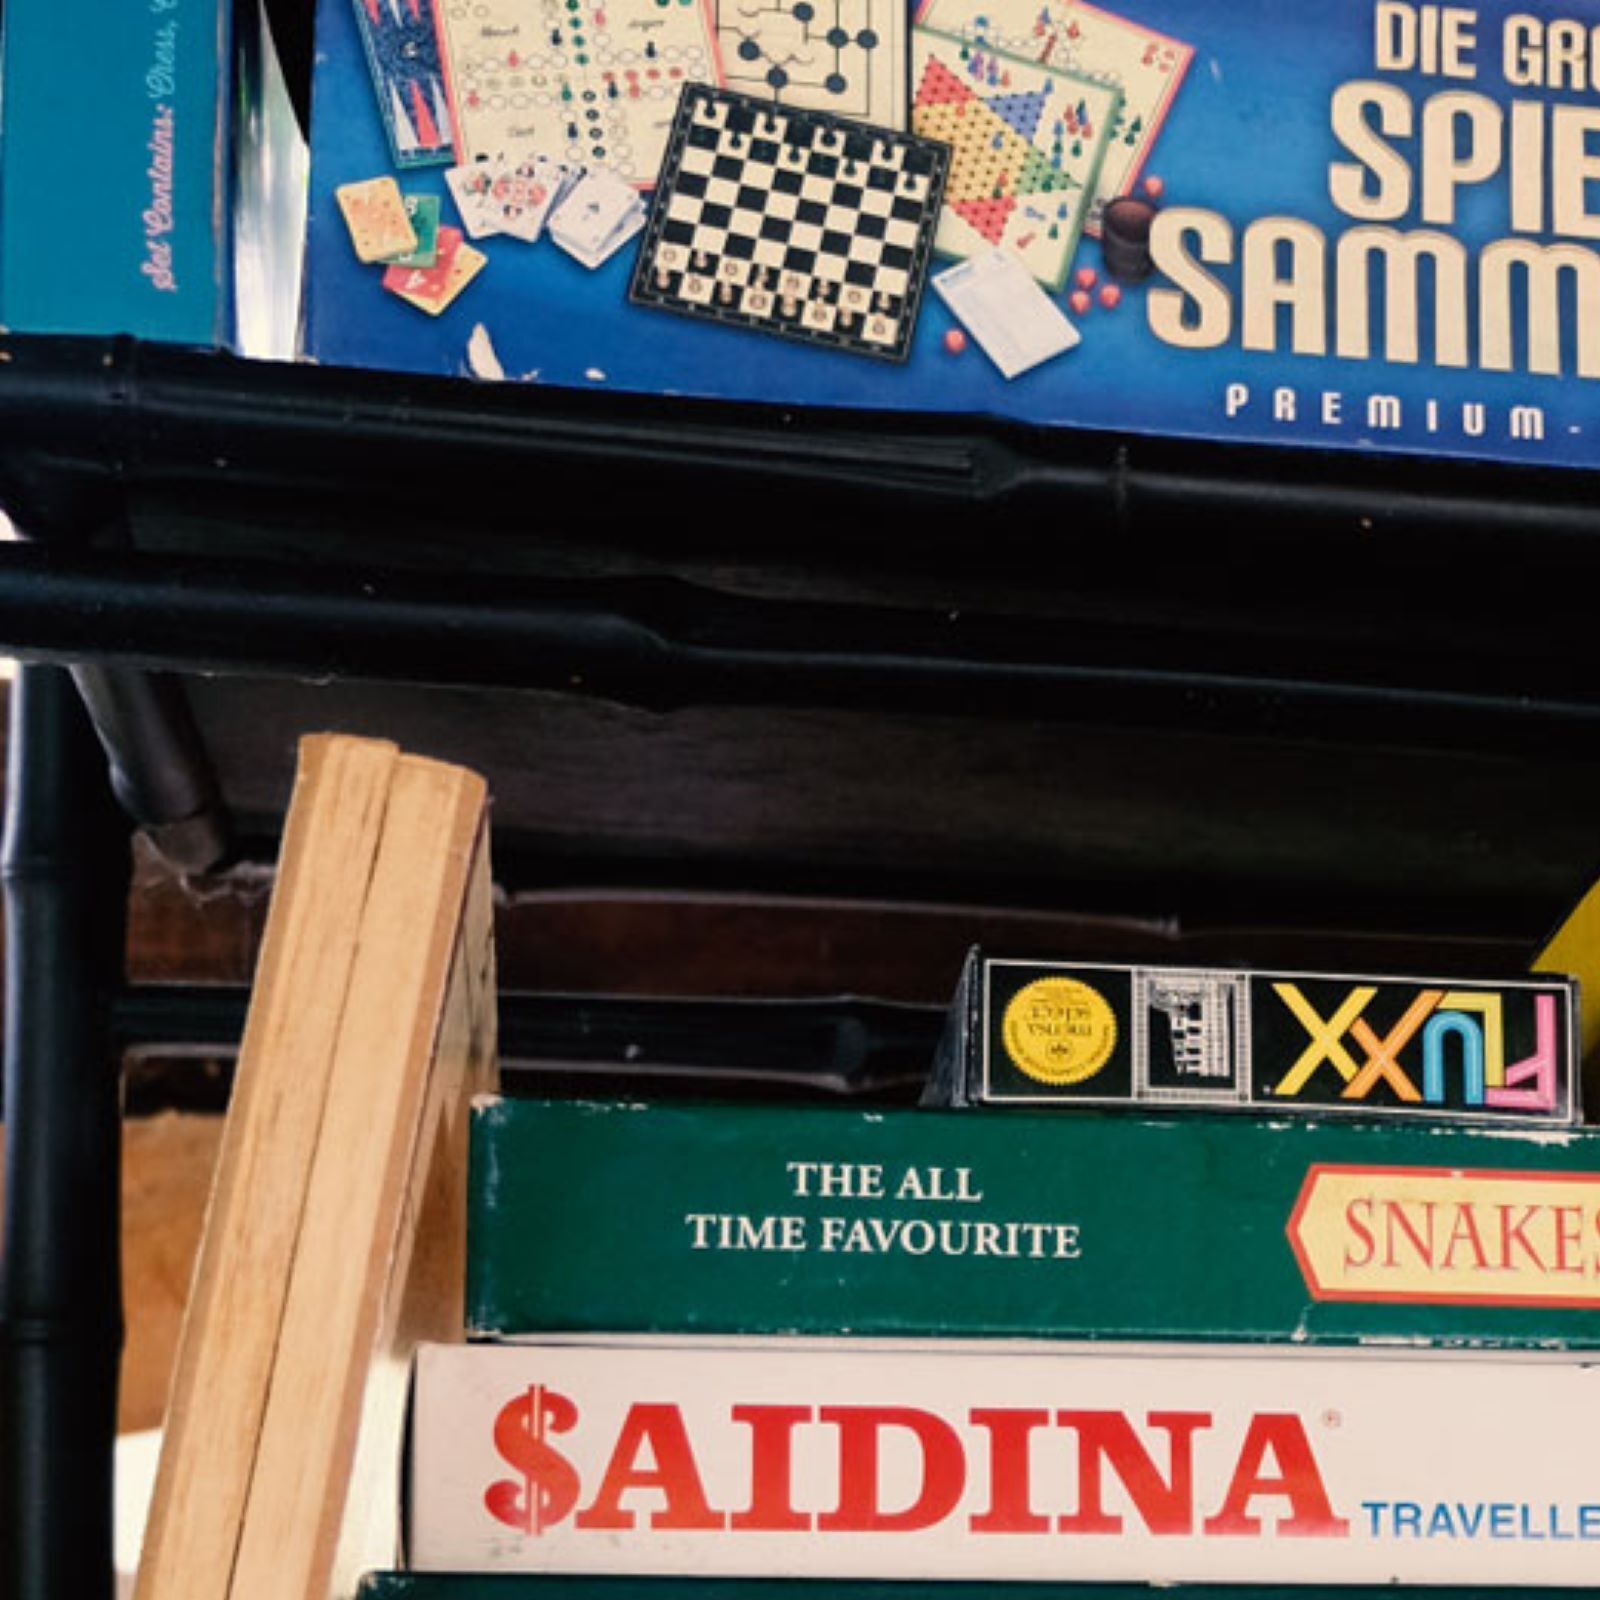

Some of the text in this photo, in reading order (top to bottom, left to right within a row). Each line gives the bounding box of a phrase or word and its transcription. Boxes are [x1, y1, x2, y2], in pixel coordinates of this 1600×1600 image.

[1376, 0, 1476, 80] DIE
[143, 103, 174, 235] Contains:
[141, 240, 177, 291] Set
[1272, 984, 1556, 1110] FLUXX
[787, 1161, 982, 1203] THE ALL
[685, 1214, 1082, 1258] TIME FAVOURITE
[483, 1382, 1350, 1537] $AIDINA
